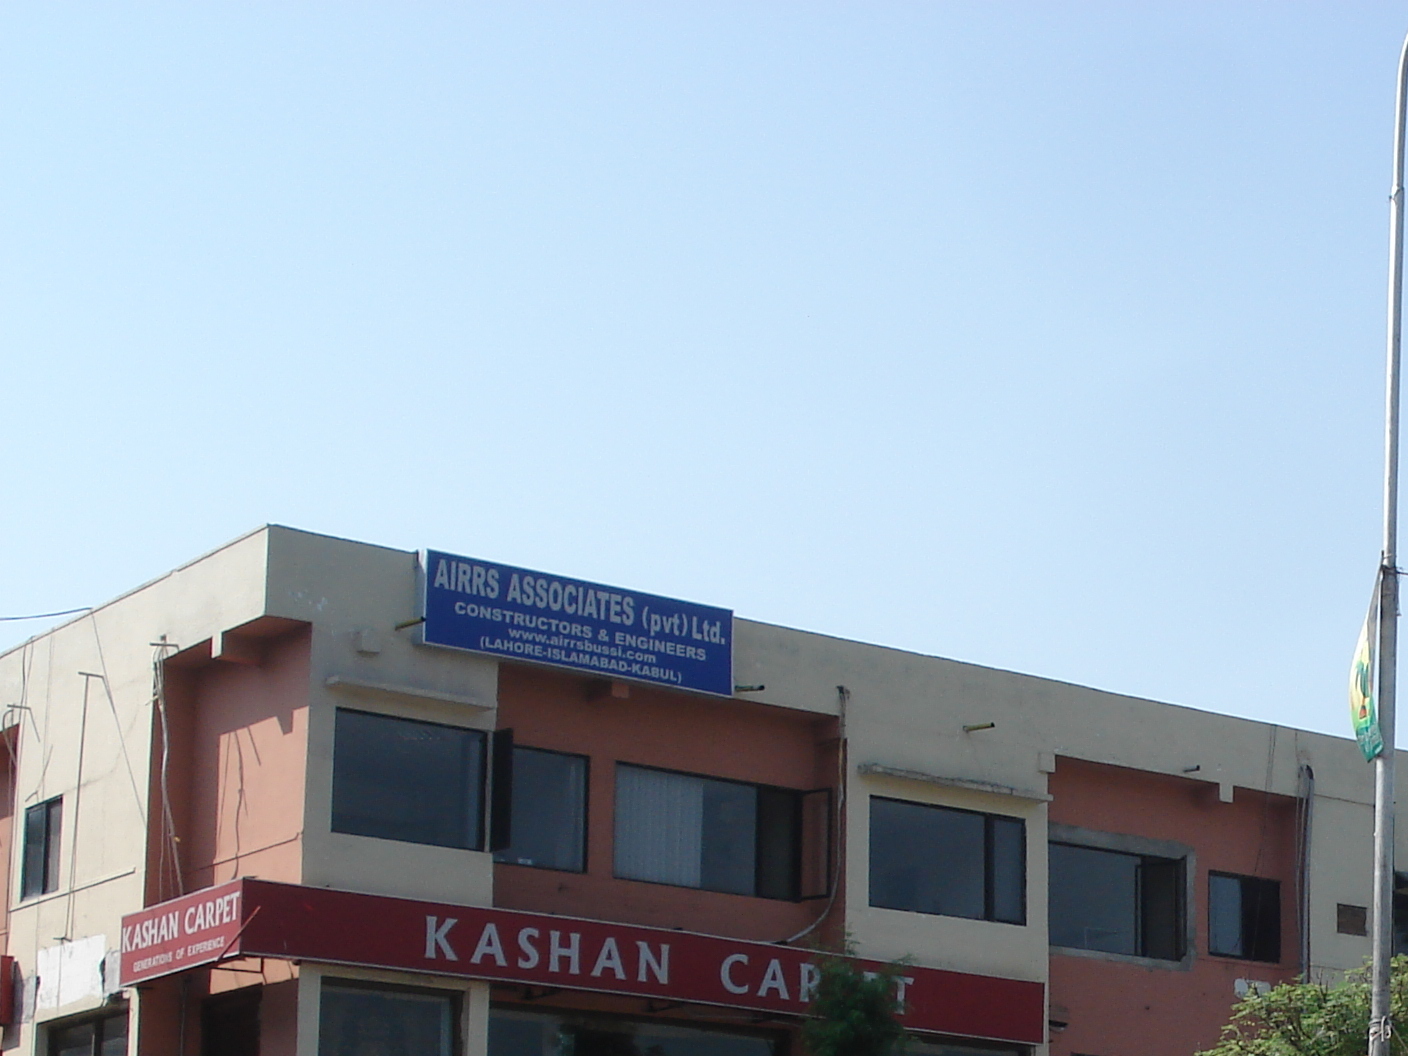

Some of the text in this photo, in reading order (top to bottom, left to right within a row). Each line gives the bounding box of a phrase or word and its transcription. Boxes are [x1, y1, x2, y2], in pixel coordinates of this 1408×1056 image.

[434, 558, 500, 599] AIRRS
[507, 573, 635, 626] ASSOCIATES
[642, 605, 688, 637] (pvt)
[454, 601, 707, 661] CONSTRUCTORS & ENGINEERS
[121, 890, 240, 954] KASHAN CARPET
[176, 947, 185, 961] OF
[187, 935, 225, 957] EXPERIENCE
[424, 915, 915, 1015] KASHAN CART
